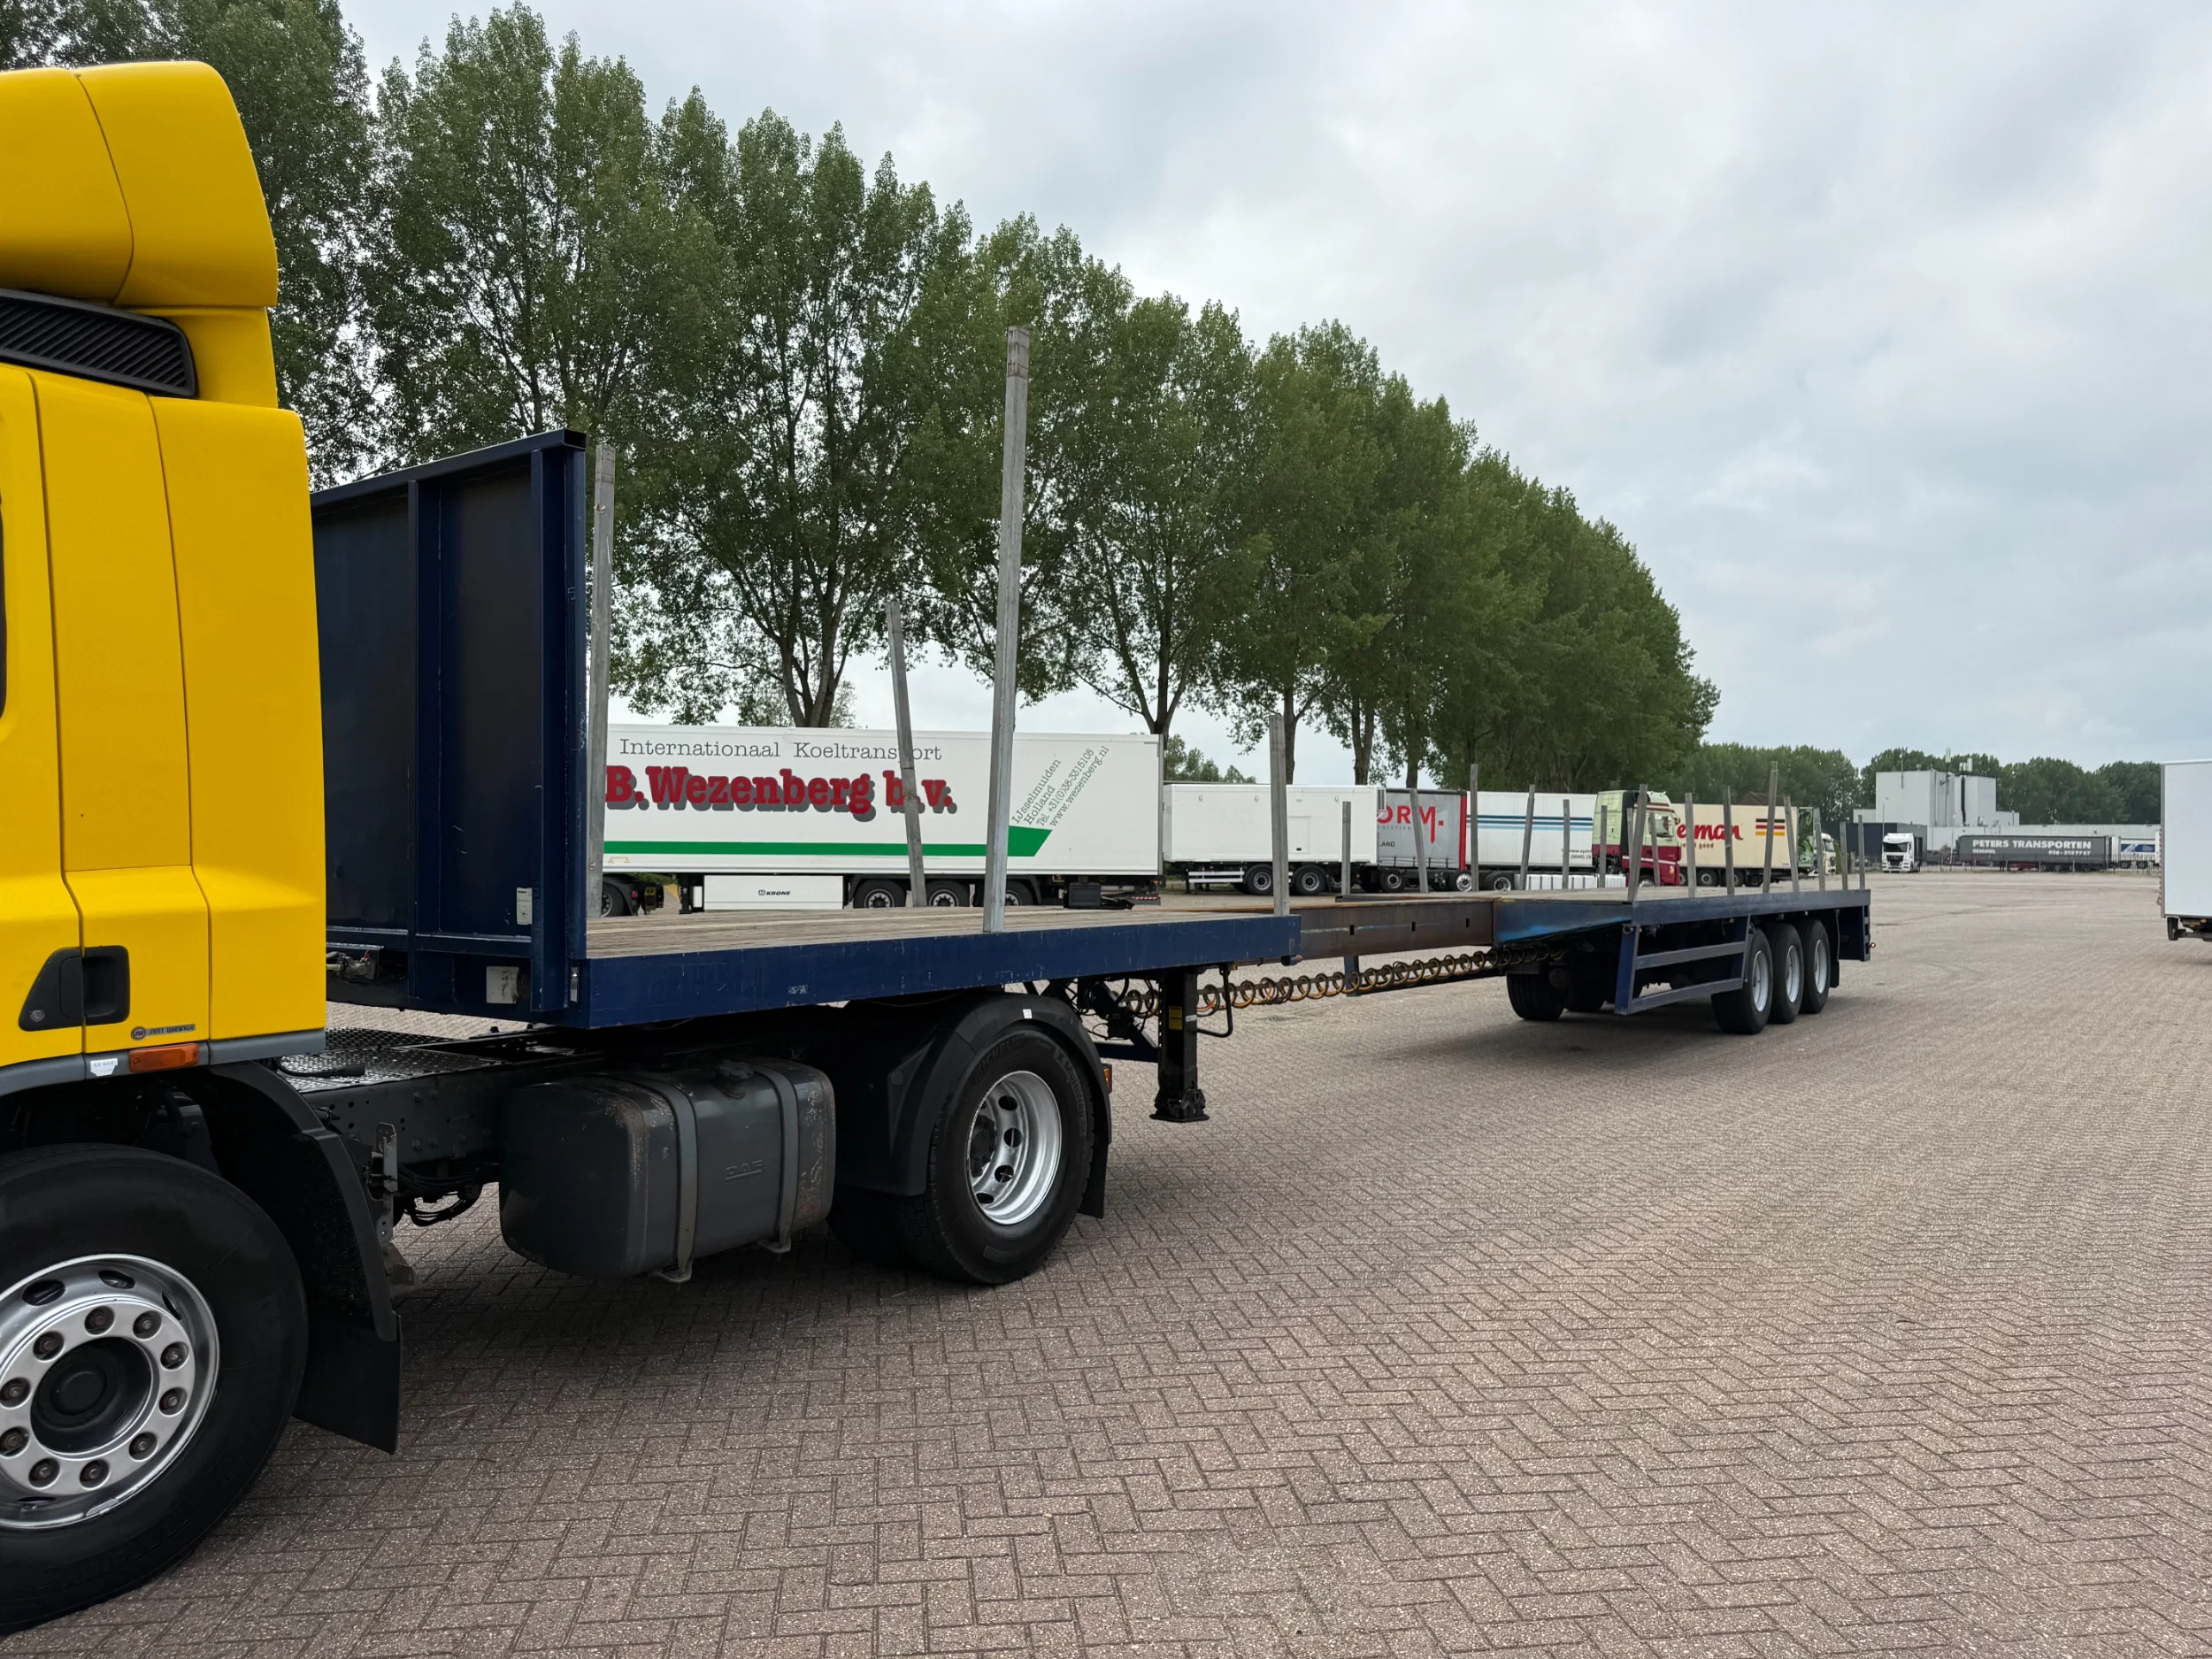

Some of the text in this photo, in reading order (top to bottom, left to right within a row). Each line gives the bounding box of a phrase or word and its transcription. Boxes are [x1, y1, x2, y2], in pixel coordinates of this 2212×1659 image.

[619, 738, 942, 764] Internationaal Koeltransort
[1011, 759, 1062, 824] IJsselmuiden
[1024, 785, 1056, 825] Holland
[1049, 745, 1110, 827] www.wezenberg.nl
[2012, 840, 2092, 849] TRANSPORTEN
